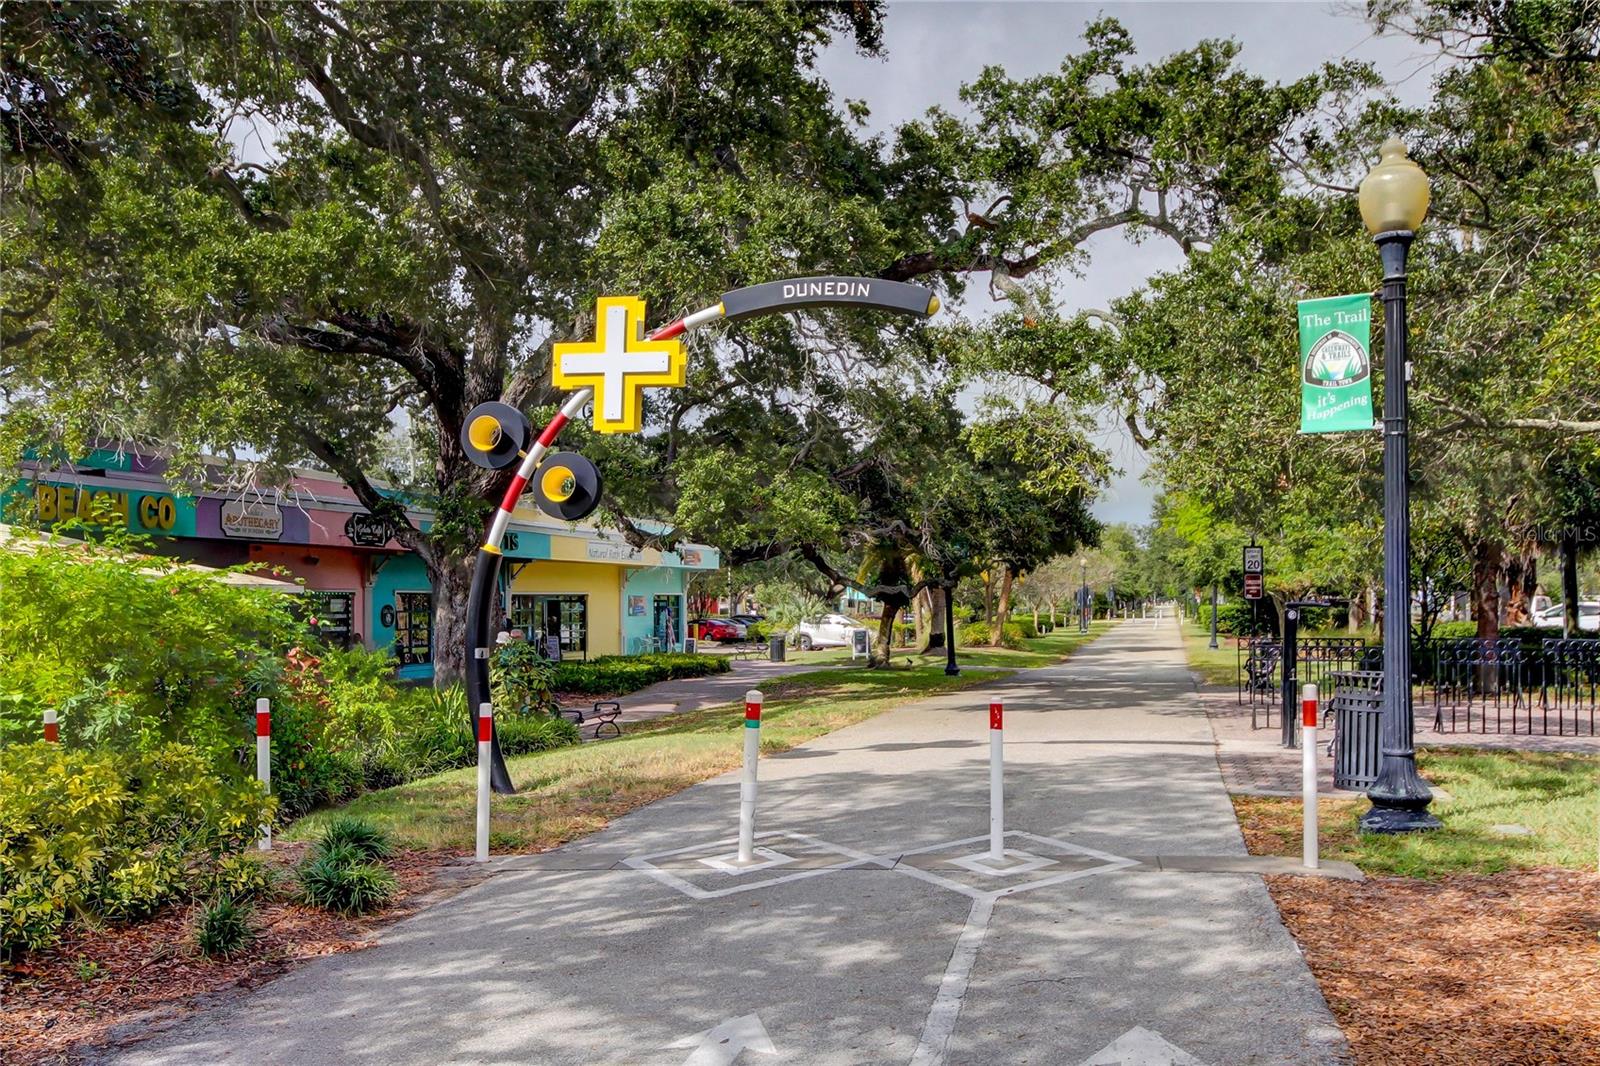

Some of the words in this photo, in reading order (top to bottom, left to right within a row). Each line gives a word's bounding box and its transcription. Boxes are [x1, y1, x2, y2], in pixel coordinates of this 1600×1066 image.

[783, 282, 870, 299] DUNEDIN
[1302, 313, 1331, 328] The
[1334, 308, 1367, 324] Trail
[1305, 394, 1368, 421] Happening
[1317, 391, 1336, 408] it's
[38, 485, 129, 528] BEACH
[141, 495, 177, 530] CO
[224, 512, 281, 530] APOTHECARY
[1247, 560, 1260, 570] 20
